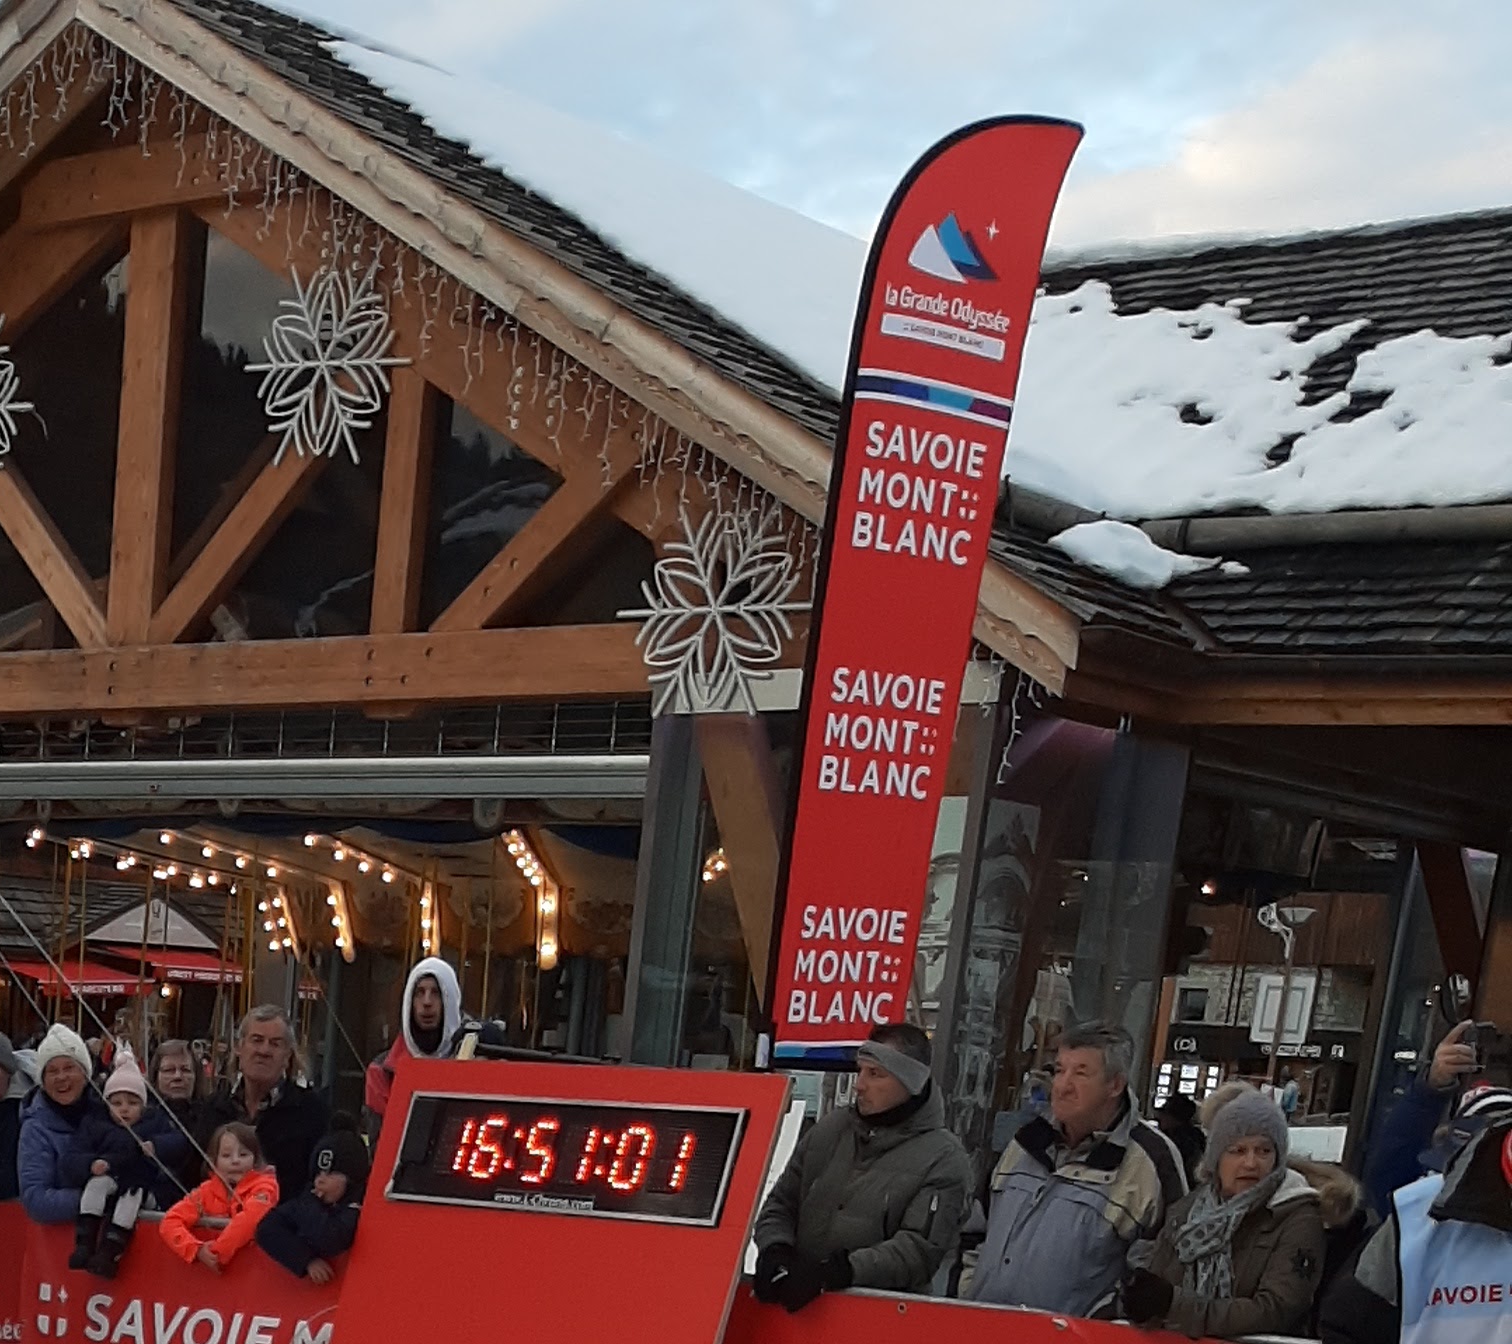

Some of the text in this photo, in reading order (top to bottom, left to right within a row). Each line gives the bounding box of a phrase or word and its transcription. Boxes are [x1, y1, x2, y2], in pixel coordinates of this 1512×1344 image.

[900, 285, 949, 317] Grande
[865, 421, 988, 479] SAVOIE
[858, 467, 959, 519] MONT
[852, 512, 972, 566] BLANC
[831, 667, 946, 715] SAVOIE
[823, 712, 919, 756] MONT
[818, 754, 931, 800] BLANC
[800, 905, 908, 945] SAVOIE
[794, 949, 880, 984] MONT
[787, 989, 893, 1025] BLANC
[452, 1112, 695, 1194] 16:51:01
[1426, 1284, 1504, 1307] AVOIE
